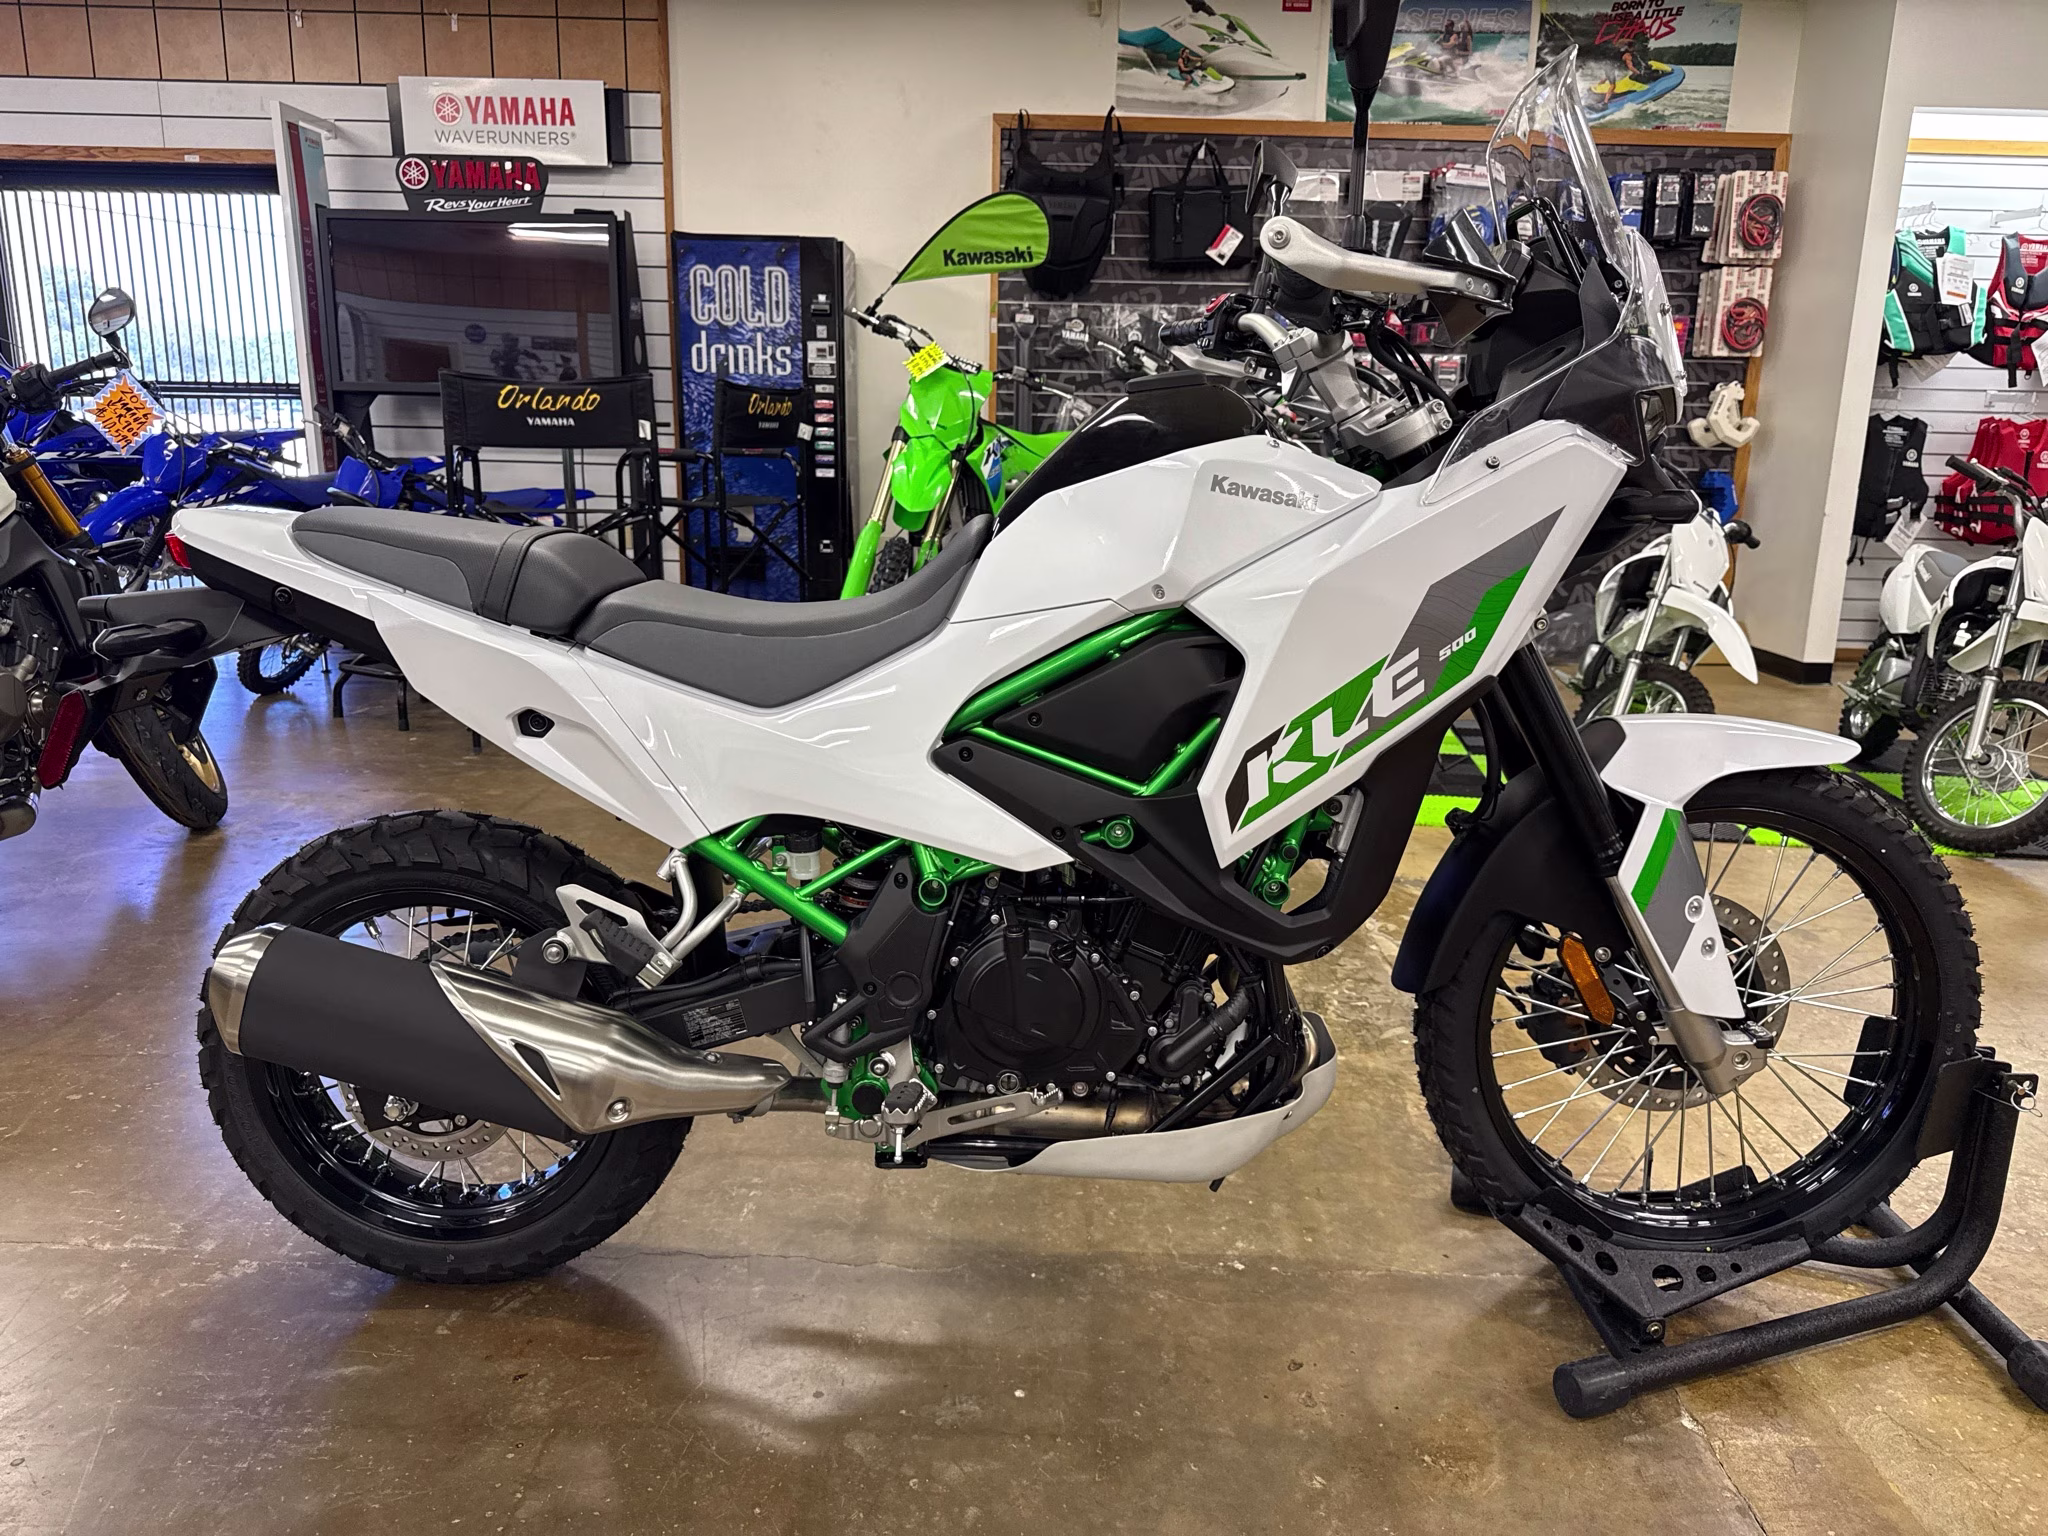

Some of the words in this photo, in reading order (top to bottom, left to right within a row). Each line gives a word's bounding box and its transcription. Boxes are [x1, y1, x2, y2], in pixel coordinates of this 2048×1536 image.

[1405, 7, 1518, 29] SERIES
[1611, 0, 1648, 12] BORN
[1648, 0, 1664, 8] TO
[1644, 6, 1685, 20] LITTLE
[1594, 16, 1677, 45] CHAOS
[464, 95, 576, 127] YAMAHA
[430, 159, 541, 191] YAMAHA
[424, 197, 467, 212] Revs
[467, 198, 498, 212] Your
[497, 195, 532, 208] Heart
[304, 224, 318, 311] APPAREL
[943, 246, 1034, 267] Kawasaki
[690, 264, 790, 327] COLD
[691, 330, 792, 376] drinks
[120, 388, 152, 420] 2026
[498, 385, 601, 411] Orlando
[748, 393, 793, 416] Orlando
[526, 416, 576, 427] YAMAHA
[1210, 474, 1319, 512] Kawasaki
[1439, 627, 1477, 662] 500
[1247, 647, 1425, 808] KLE
